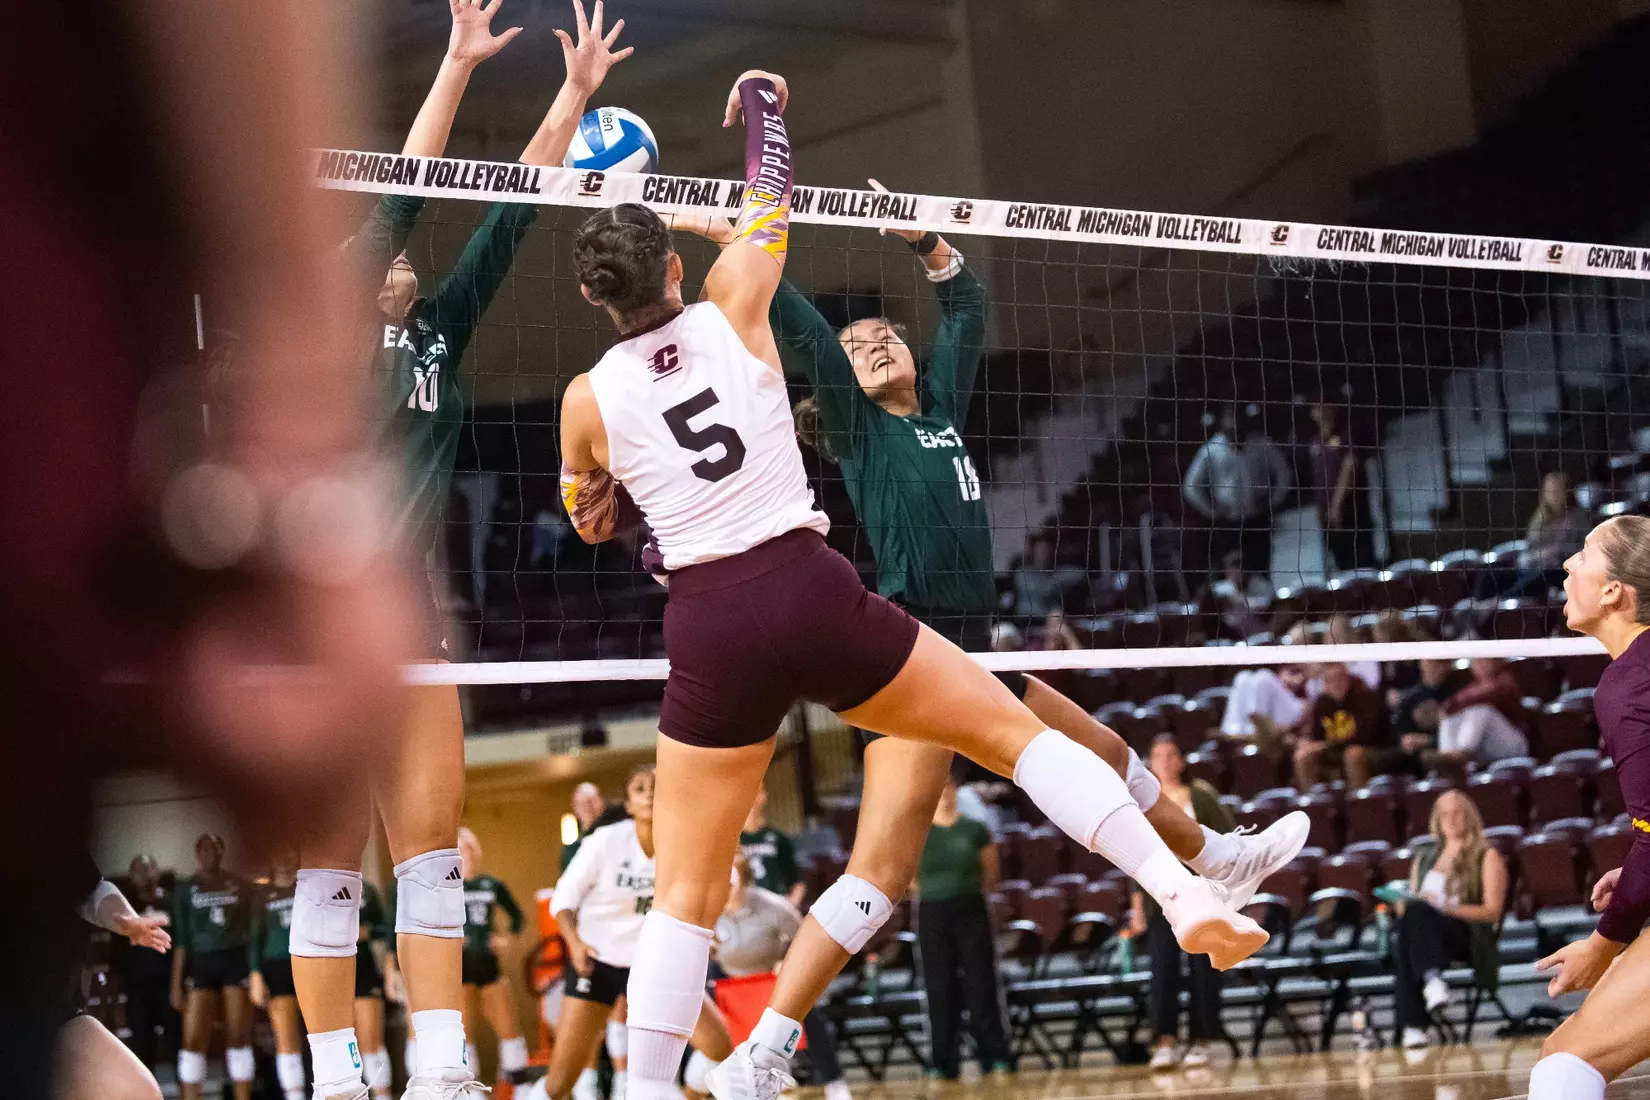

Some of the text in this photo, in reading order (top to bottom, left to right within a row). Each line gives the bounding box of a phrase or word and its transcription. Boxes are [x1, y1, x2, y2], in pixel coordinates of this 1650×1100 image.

[316, 151, 541, 194] MICHIGAN VOLLEYBALL
[750, 112, 790, 207] CHIPPEWAS
[642, 177, 719, 206] CENTRAL
[816, 190, 917, 221] VOLLEYBALL
[1005, 204, 1242, 244] CENTRAL MICHIGAN VOLLEYBALL
[1317, 228, 1522, 262] CENTRAL MICHIGAN VOLLEYBALL
[1587, 246, 1637, 270] CENTRAL
[408, 363, 440, 412] 10
[661, 386, 746, 483] 5
